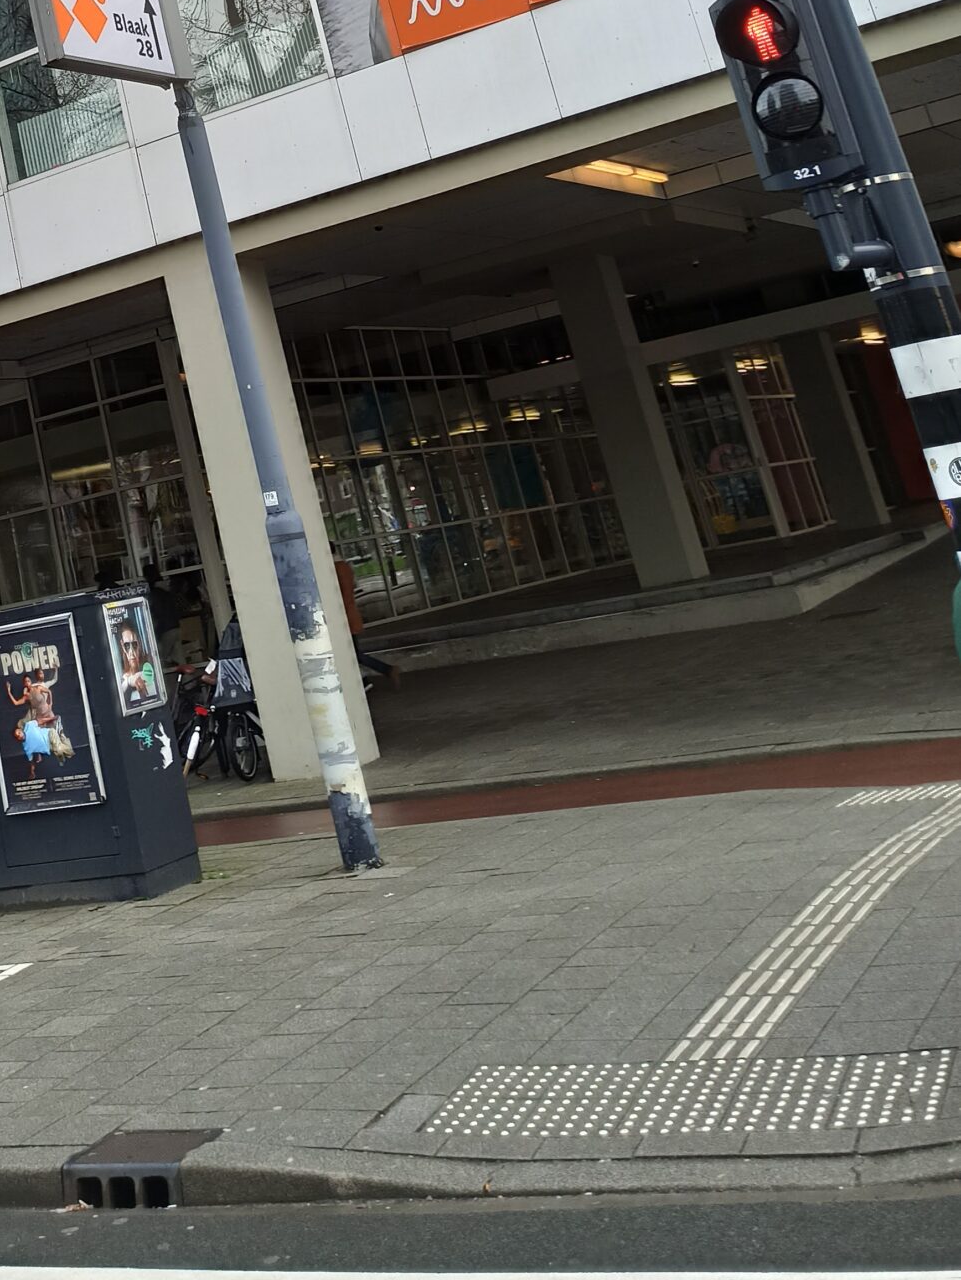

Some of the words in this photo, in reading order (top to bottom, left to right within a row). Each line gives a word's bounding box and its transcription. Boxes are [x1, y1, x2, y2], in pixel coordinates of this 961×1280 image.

[113, 13, 150, 38] Blaak
[136, 38, 154, 59] 28
[793, 165, 821, 180] 32.1
[0, 644, 60, 676] POWER
